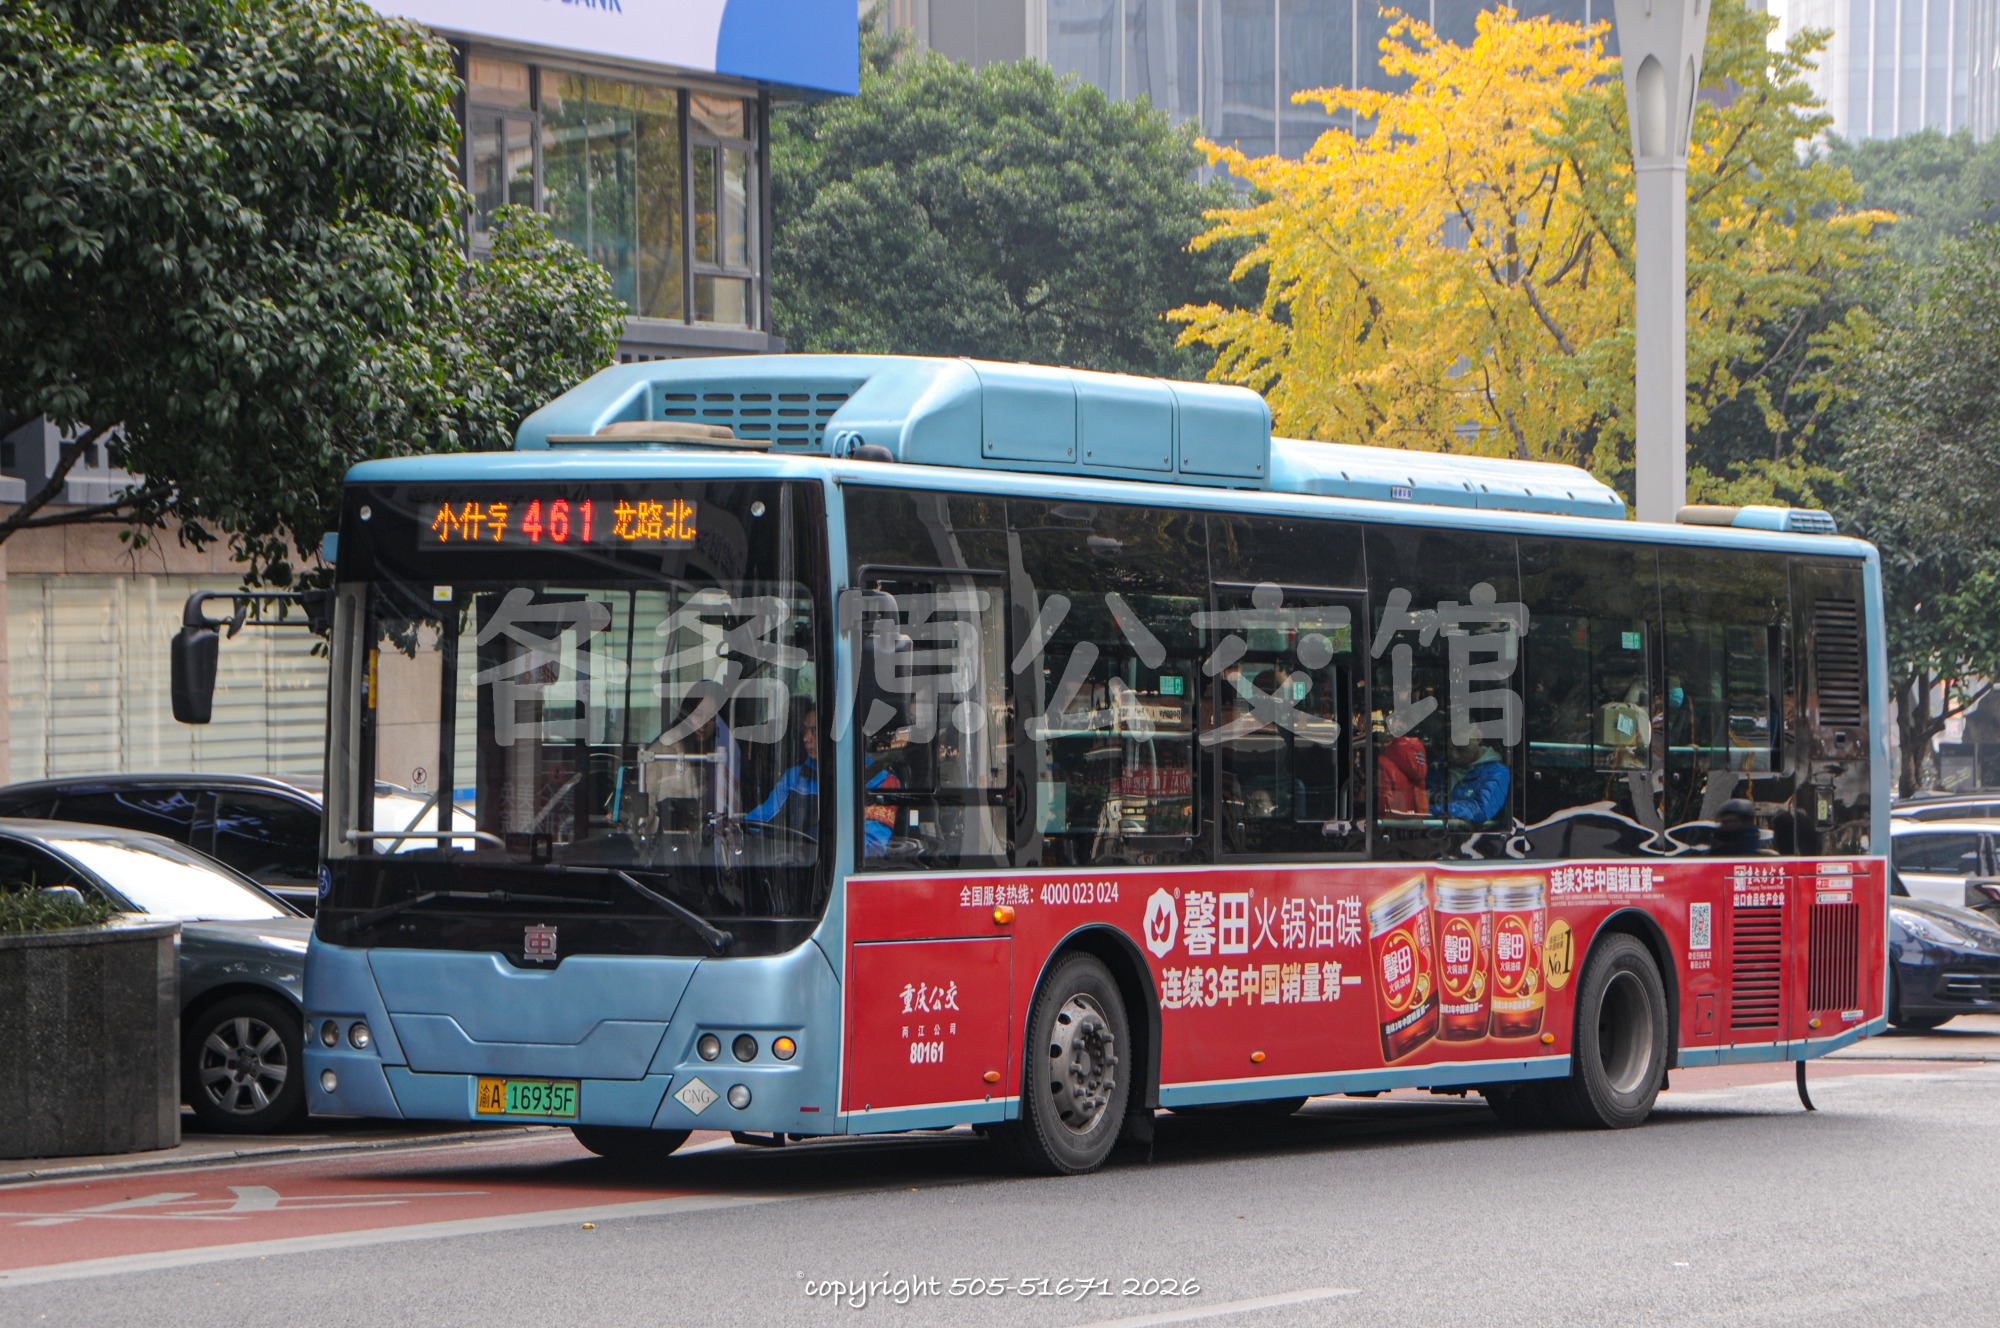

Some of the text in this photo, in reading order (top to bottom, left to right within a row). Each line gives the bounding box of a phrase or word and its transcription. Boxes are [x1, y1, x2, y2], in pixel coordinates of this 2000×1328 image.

[522, 500, 593, 542] 461
[613, 499, 697, 540] 龙路北
[1040, 883, 1070, 904] 4000
[1072, 882, 1094, 904] 023
[1096, 882, 1119, 903] 024
[1550, 866, 1664, 894] 连续3年中国销量第一
[1734, 892, 1785, 907] 出口食品生产企业
[1183, 890, 1249, 956] 馨田
[1252, 895, 1361, 950] 火锅油碟
[1444, 934, 1471, 963] 馨田
[1497, 932, 1524, 960] 馨田
[1383, 945, 1412, 983] 馨田
[899, 980, 960, 1014] 重庆公交
[1159, 961, 1361, 1009] 连续3年中国销量第一
[902, 1022, 957, 1038] 两江公司
[910, 1041, 944, 1064] 80161
[682, 1089, 710, 1104] CNG
